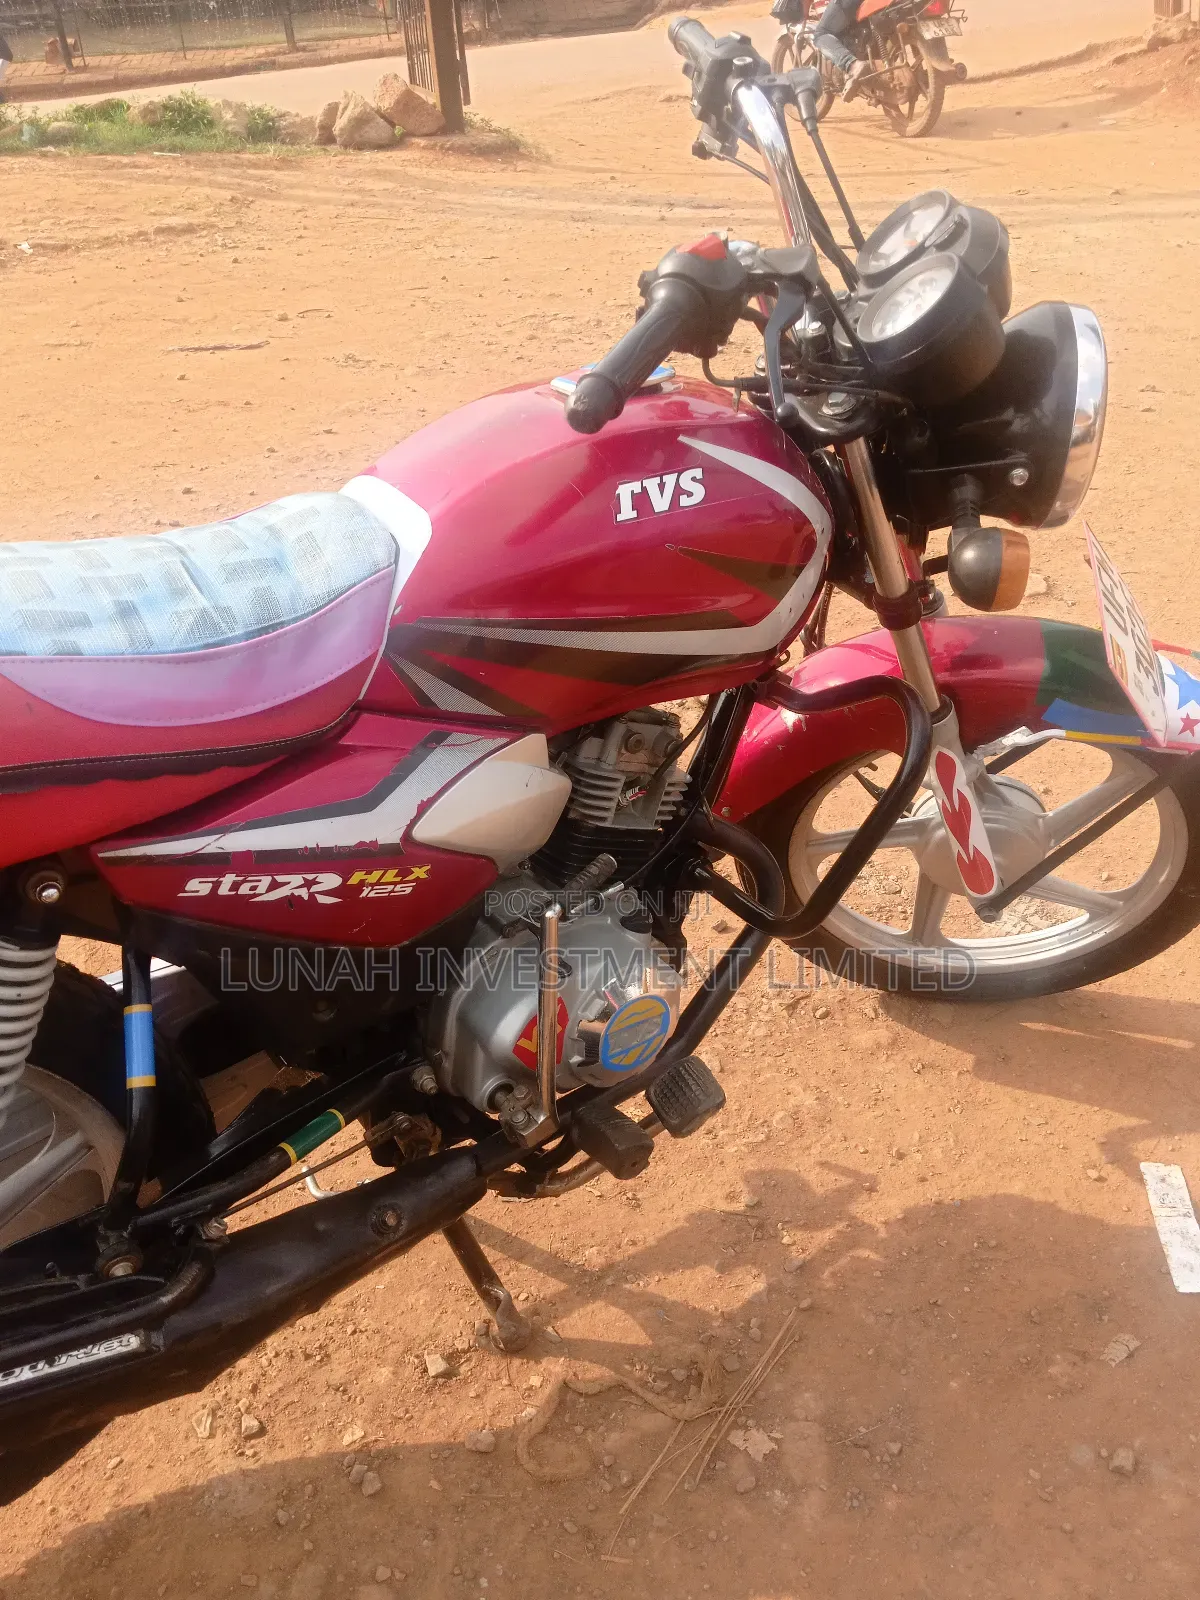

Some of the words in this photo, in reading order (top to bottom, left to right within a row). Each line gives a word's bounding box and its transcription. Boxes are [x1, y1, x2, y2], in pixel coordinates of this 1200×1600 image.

[614, 467, 707, 523] TVS
[346, 865, 432, 885] HLX
[358, 882, 417, 898] 125
